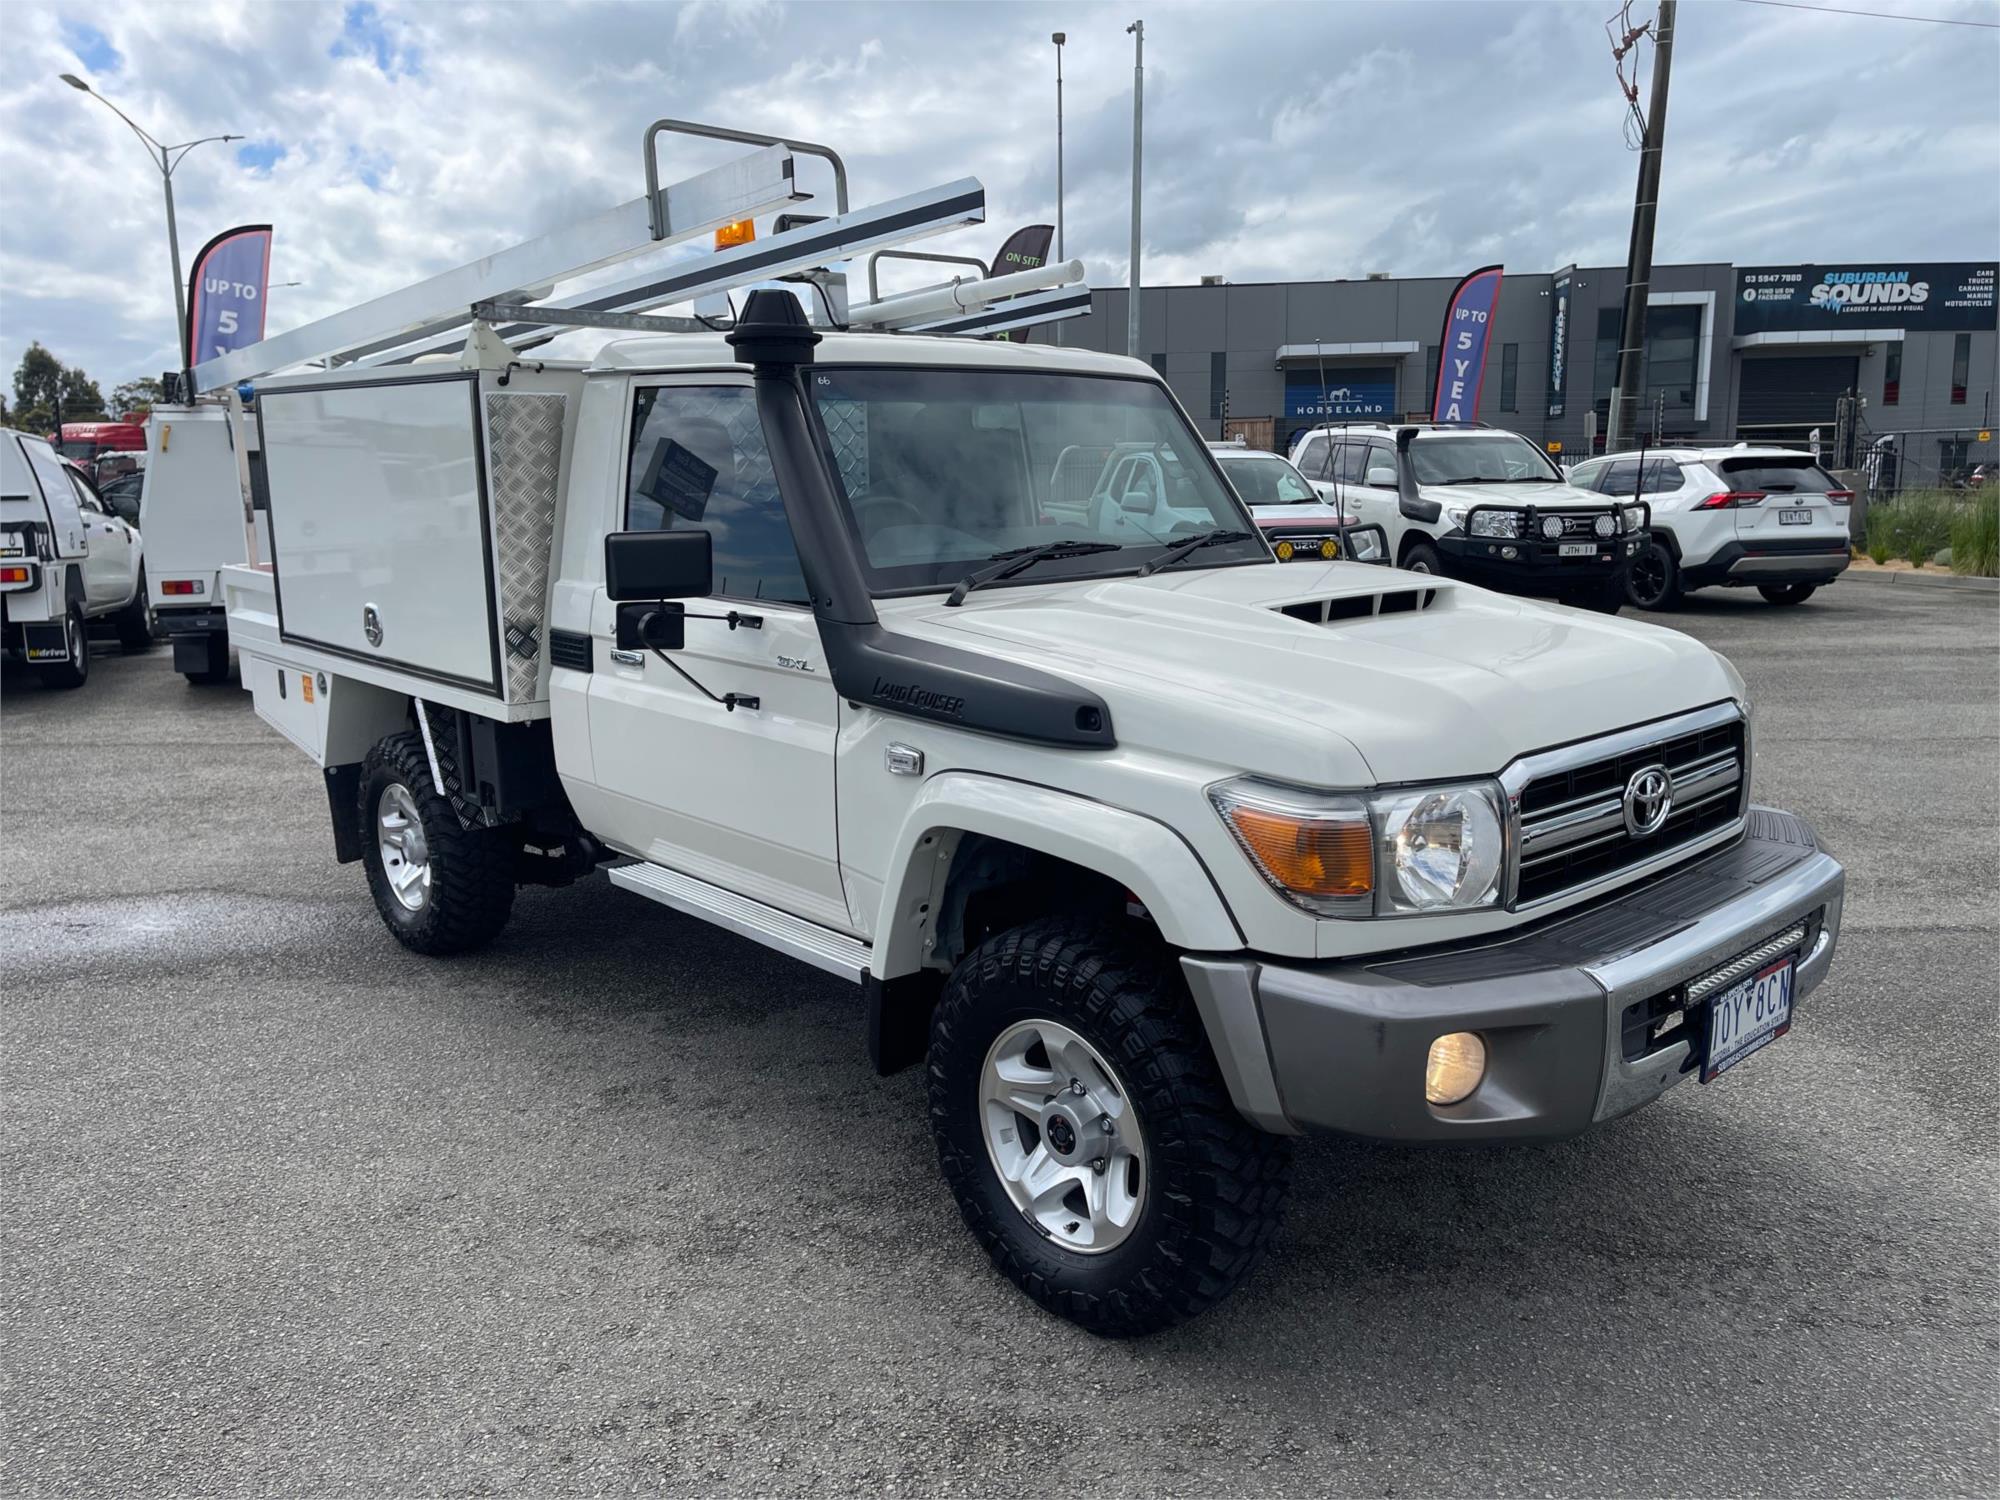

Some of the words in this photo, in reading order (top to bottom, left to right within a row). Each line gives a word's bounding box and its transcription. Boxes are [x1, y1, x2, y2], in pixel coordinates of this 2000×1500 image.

[1006, 252, 1021, 263] ON
[1022, 255, 1041, 267] SITE
[1745, 275, 1756, 283] 03
[1823, 271, 1909, 284] SUBURBAN
[205, 277, 230, 295] UP
[232, 281, 257, 300] TO
[1809, 282, 1929, 305] SOUNDS
[217, 309, 239, 334] 5
[1456, 307, 1469, 320] UP
[1471, 310, 1487, 323] TO
[1457, 331, 1472, 350] 5
[1446, 358, 1470, 422] YEA
[1297, 405, 1383, 415] HORSELAND
[28, 648, 66, 657] hidrive
